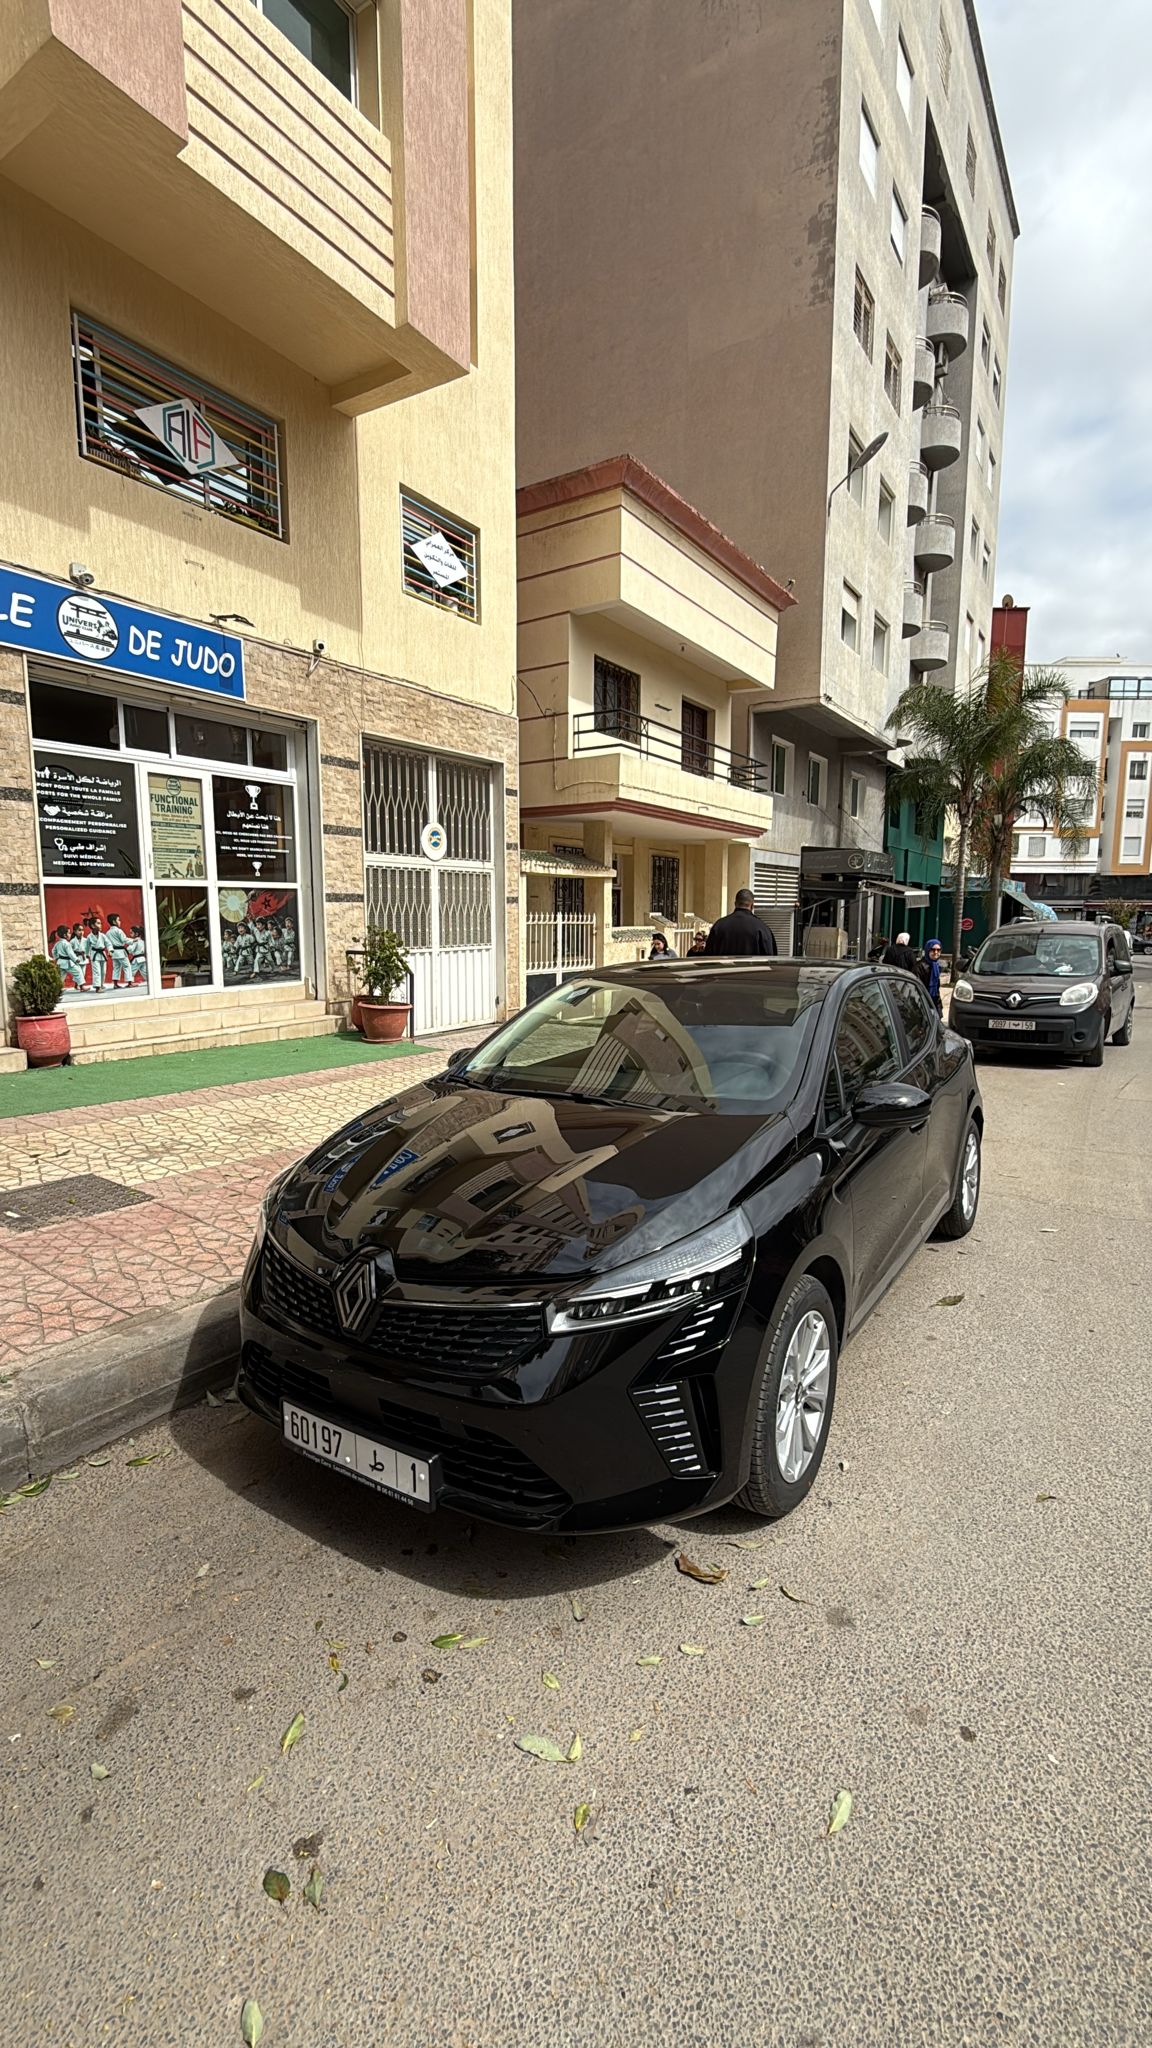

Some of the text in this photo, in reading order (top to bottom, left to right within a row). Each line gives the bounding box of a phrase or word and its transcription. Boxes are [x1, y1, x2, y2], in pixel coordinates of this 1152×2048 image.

[0, 592, 236, 679] E DE JUDO
[52, 771, 122, 788] الرياضة لكل الأسرة
[98, 788, 121, 796] FAMILLE
[150, 793, 199, 807] FUNCTIONAL
[61, 806, 113, 819] مرافقة شخصية
[155, 803, 193, 815] TRAINING
[39, 816, 87, 825] COMPAGNEMENT
[69, 842, 85, 853] طبي
[290, 1410, 342, 1458] 60197
[410, 1462, 417, 1494] 1
